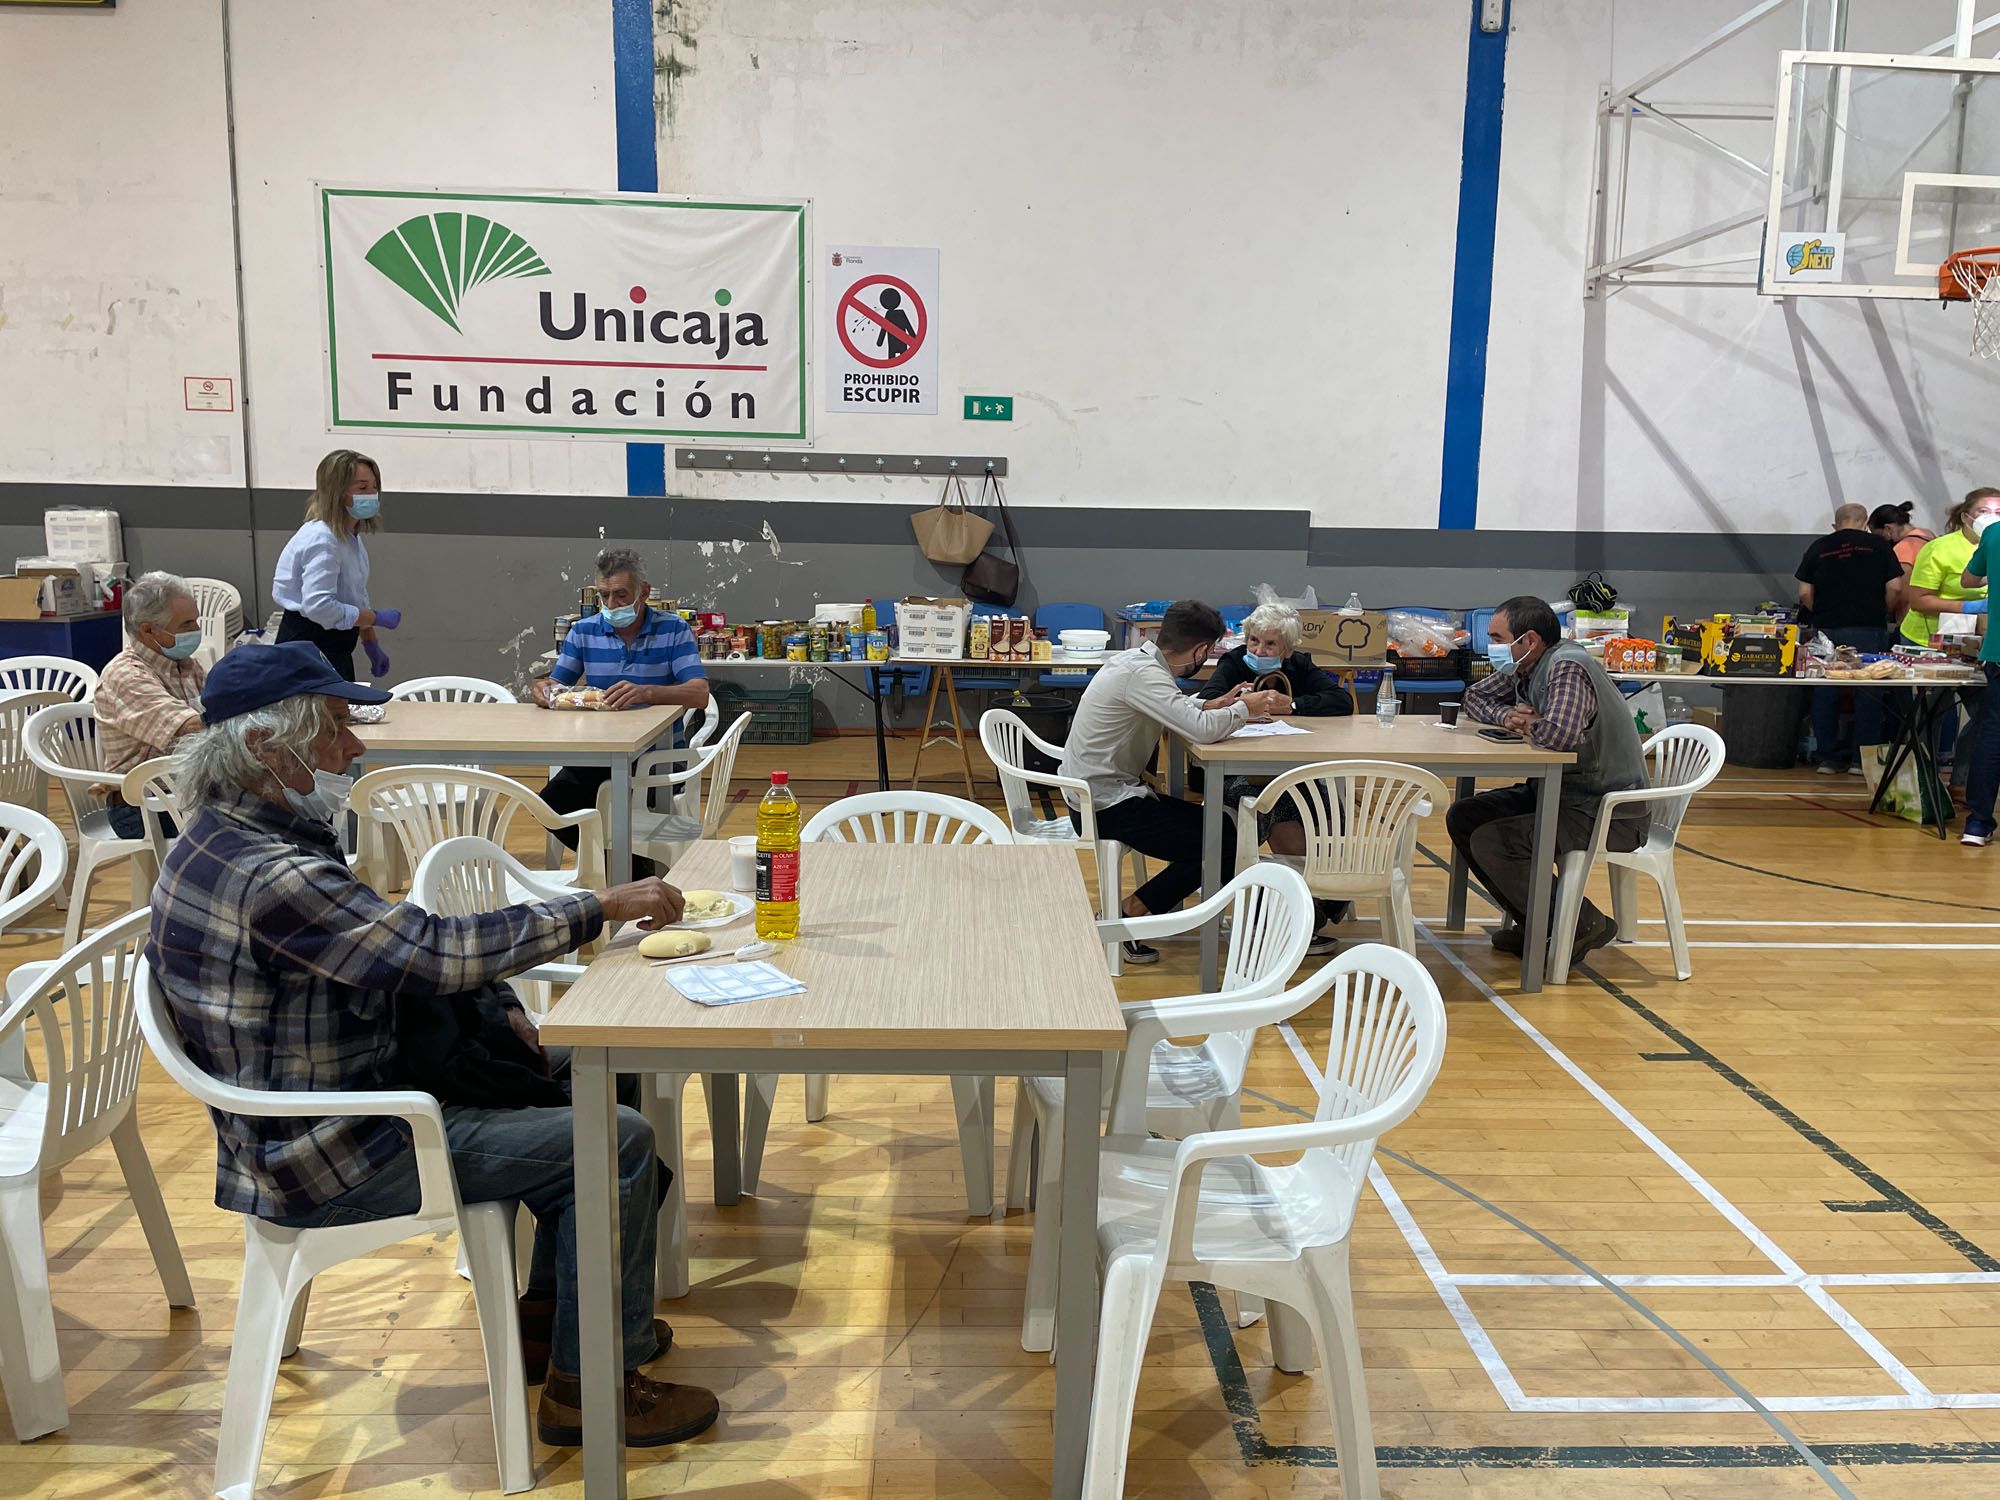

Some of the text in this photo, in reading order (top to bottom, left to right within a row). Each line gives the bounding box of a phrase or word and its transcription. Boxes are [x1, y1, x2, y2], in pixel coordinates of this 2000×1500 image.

[1808, 254, 1834, 269] NEXT
[538, 285, 768, 361] Unicaja
[844, 373, 919, 386] PROHIBIDO
[387, 371, 756, 420] Fundación
[843, 387, 920, 403] ESCUPIR
